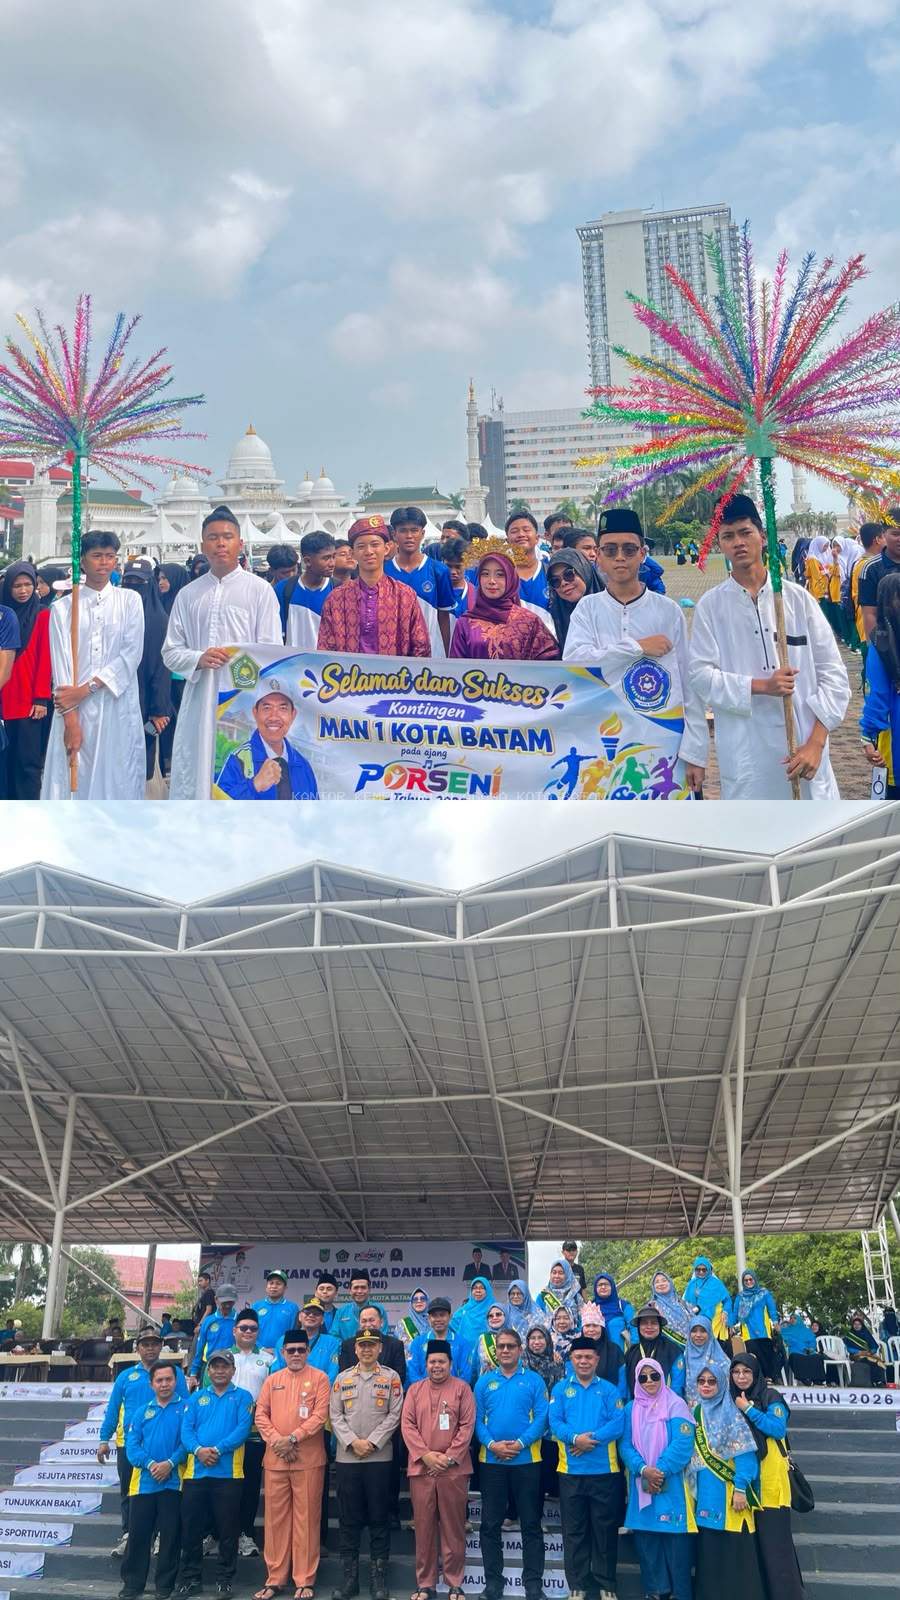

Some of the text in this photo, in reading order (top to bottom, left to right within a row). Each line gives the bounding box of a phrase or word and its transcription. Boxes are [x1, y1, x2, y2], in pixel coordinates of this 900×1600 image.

[318, 662, 550, 710] Selamat dan Sukses
[388, 702, 465, 719] Kontingen
[319, 716, 554, 753] MAN 1 KOTA BATAM
[400, 747, 448, 760] pada ajang
[354, 762, 503, 797] PORSENI
[391, 1267, 421, 1278] DAN
[424, 1266, 456, 1277] SENI
[849, 1393, 894, 1405] 2026
[60, 1448, 79, 1456] SATU
[37, 1472, 104, 1481] SEJUTA PRESTASI
[4, 1497, 82, 1508] TUNJUKKAN BAKAT
[4, 1528, 59, 1539] SPORTIVITAS
